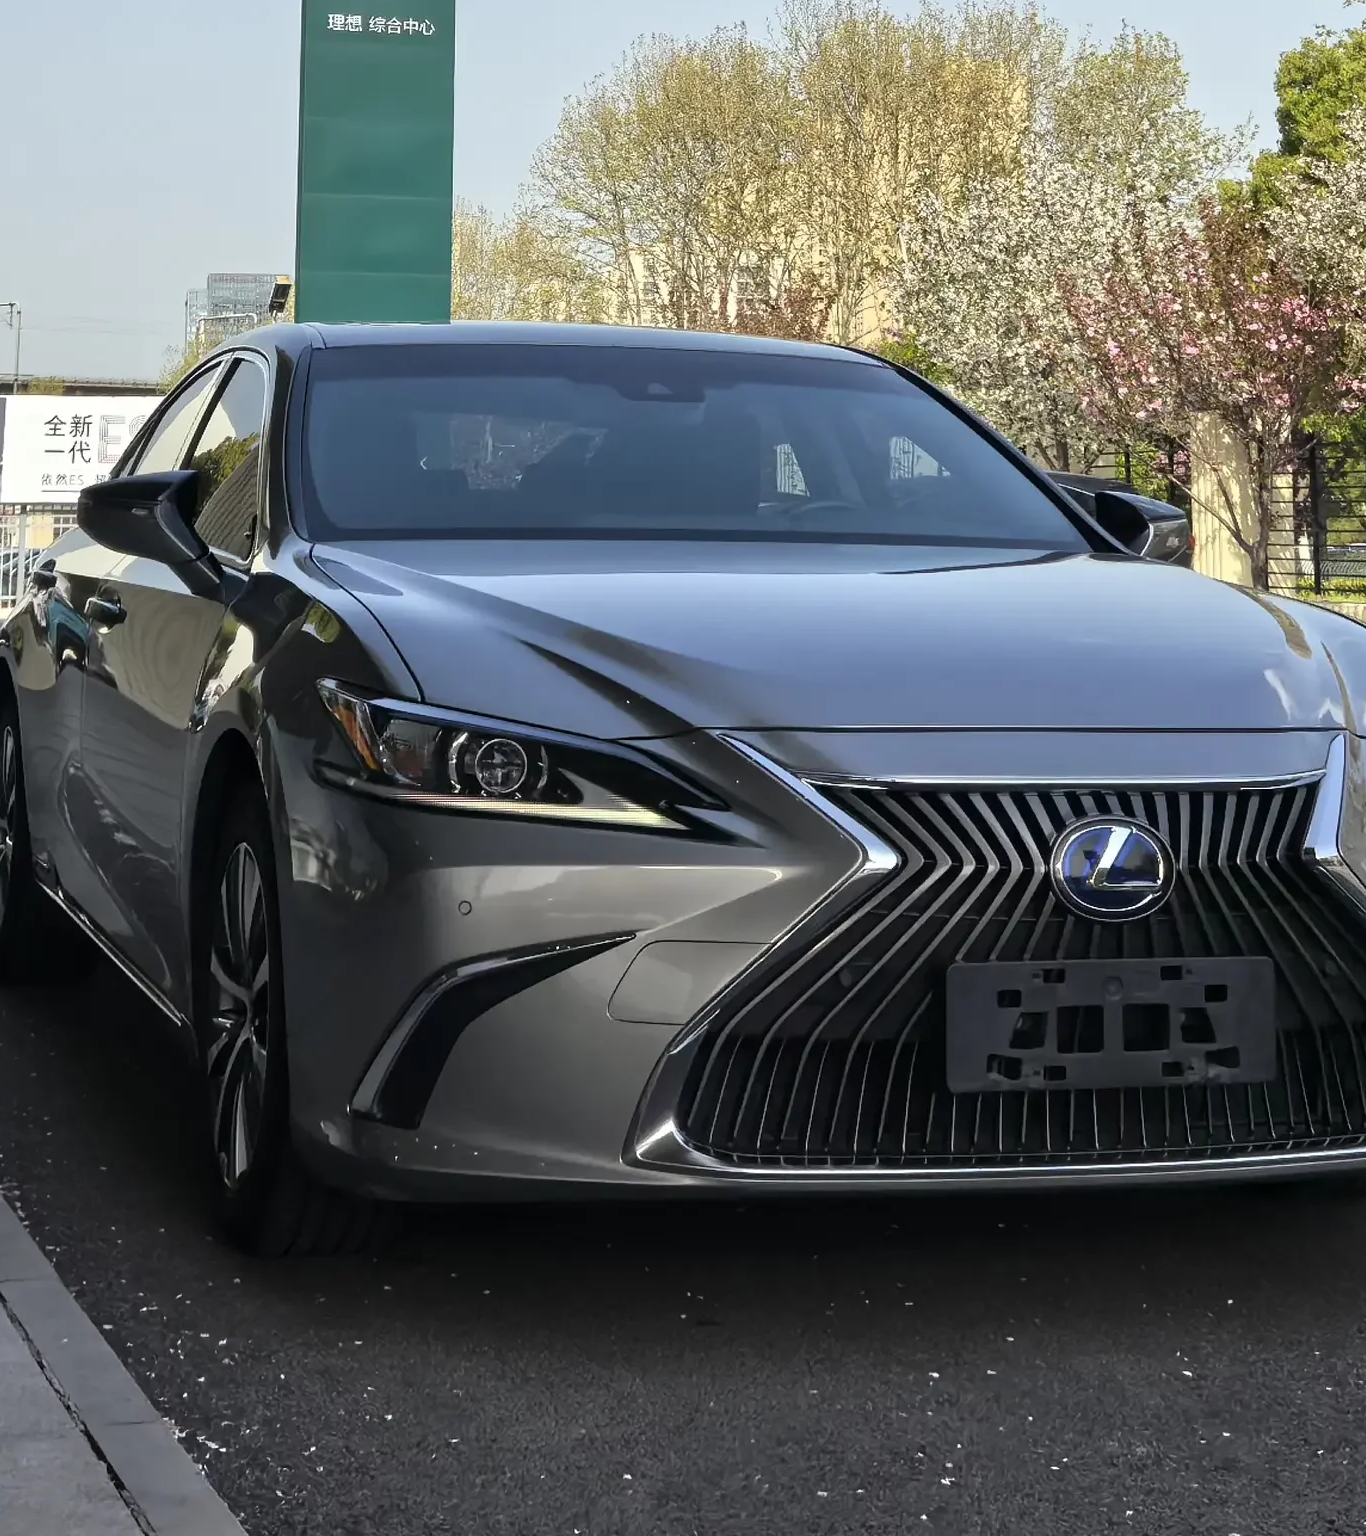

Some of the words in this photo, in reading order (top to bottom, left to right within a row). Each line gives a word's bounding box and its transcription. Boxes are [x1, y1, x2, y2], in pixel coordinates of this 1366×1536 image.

[327, 13, 363, 32] 理想
[369, 16, 435, 36] 综合中心
[43, 414, 93, 437] 全新
[43, 440, 91, 464] 一代
